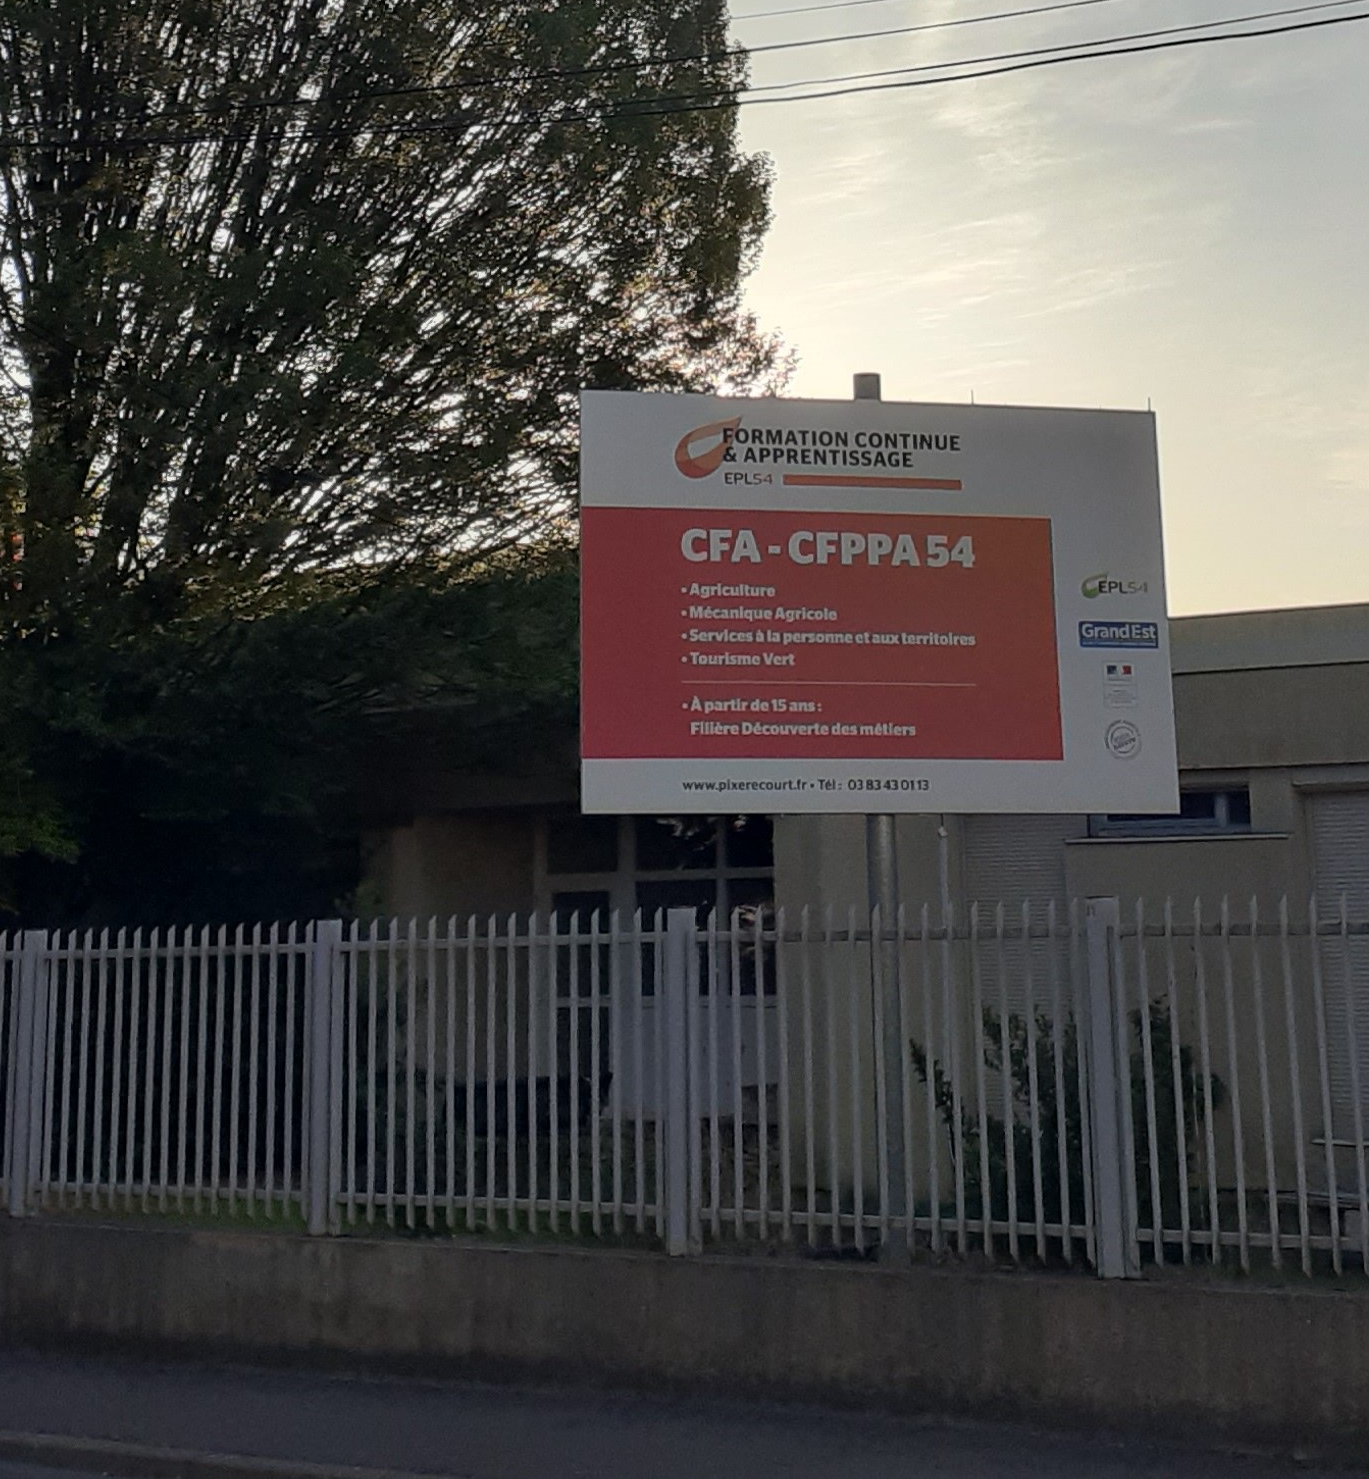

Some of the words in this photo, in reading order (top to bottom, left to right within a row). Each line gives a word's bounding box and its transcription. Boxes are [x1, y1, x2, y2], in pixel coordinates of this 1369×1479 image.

[722, 427, 848, 448] FORMATION
[854, 431, 961, 451] CONTINUE
[722, 446, 737, 463] &
[743, 447, 914, 467] APPRENTISSAGE
[724, 472, 774, 485] EPL54
[681, 528, 762, 562] CFA
[788, 531, 921, 567] CFPPA
[926, 535, 976, 568] 54
[689, 583, 776, 599] Agriculture
[1098, 580, 1148, 594] EPL54
[689, 606, 772, 622] Mécanique
[775, 606, 838, 622] Agricole
[689, 629, 753, 643] Services
[755, 629, 763, 643] à
[767, 630, 780, 643] la
[783, 632, 853, 646] personne
[855, 632, 870, 644] et
[872, 634, 899, 645] aux
[901, 632, 976, 647] territoires
[690, 652, 761, 666] Tourisme
[763, 652, 795, 666] Vert
[690, 696, 703, 712] À
[704, 699, 748, 714] partir
[750, 699, 769, 712] de
[771, 699, 787, 712] 15
[690, 721, 740, 735] Filière
[741, 721, 829, 736] Découverte
[831, 722, 858, 736] des
[859, 722, 916, 737] métiers
[682, 777, 806, 793] www.pixerecourt.fr
